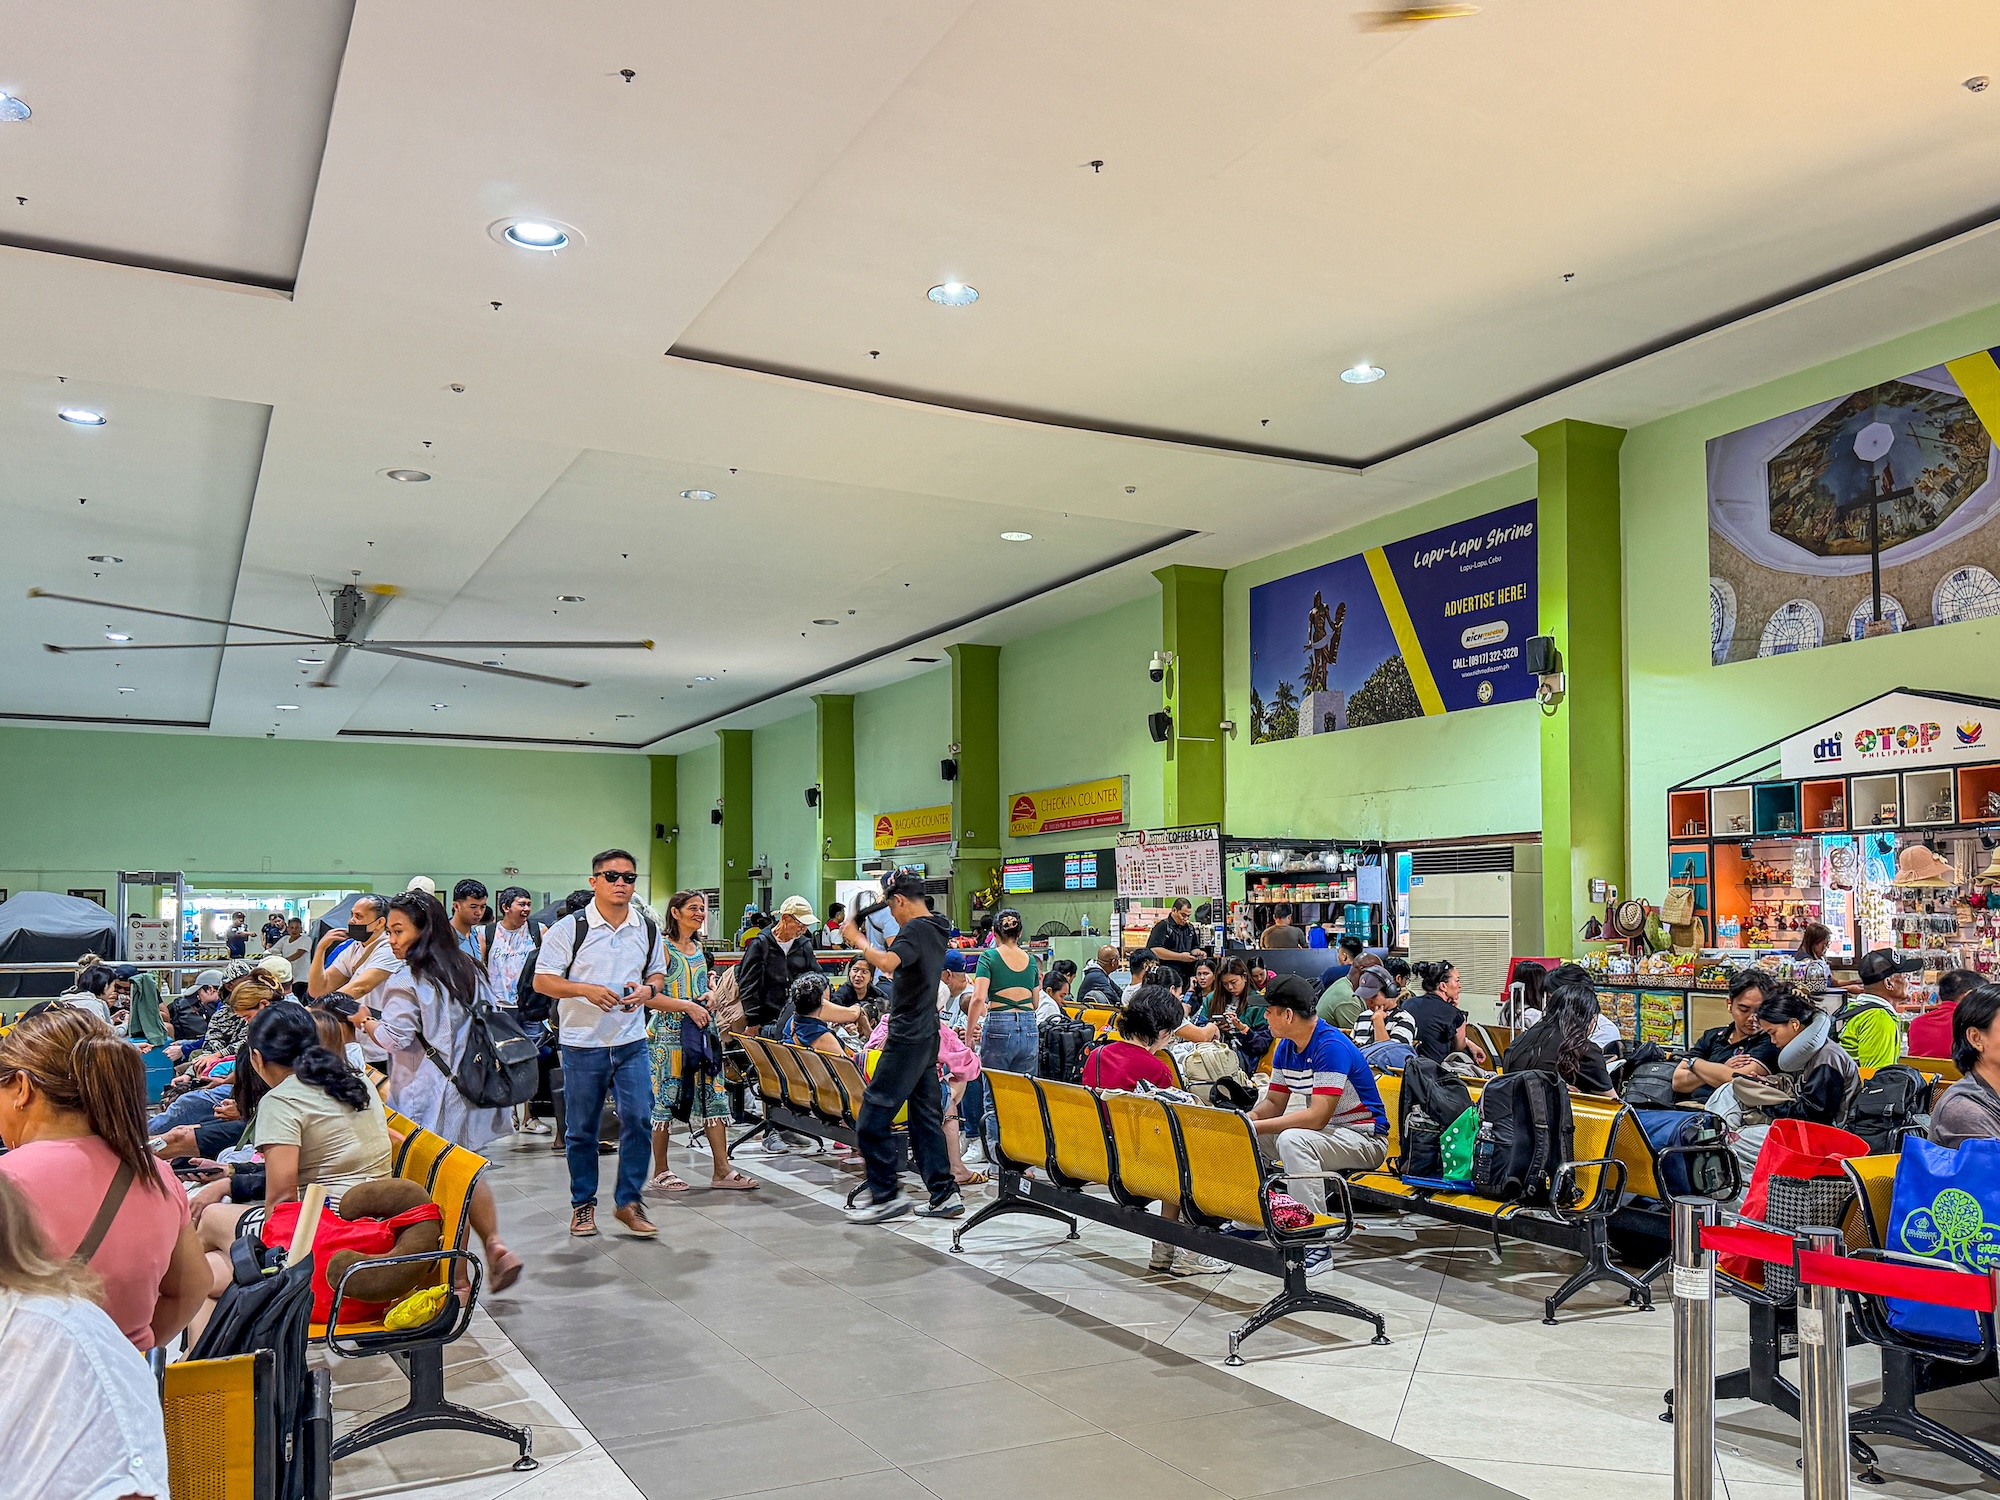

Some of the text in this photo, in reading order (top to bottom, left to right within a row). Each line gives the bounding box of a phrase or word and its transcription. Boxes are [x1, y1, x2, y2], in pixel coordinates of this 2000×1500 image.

[1413, 522, 1533, 568] Lapu-Lapu Shrine
[1488, 555, 1502, 566] Cebu
[1444, 582, 1527, 617] ADVERTISE HERE!
[1452, 646, 1519, 669] CALL: (0917) 322-3220
[1814, 722, 1941, 758] dti OTOP
[1862, 746, 1933, 759] PHILIPPINES
[1041, 787, 1118, 812] CHECK-IN COUNTER
[895, 813, 949, 831] BAGGAGE COUNTER
[1011, 821, 1036, 833] OCEANJET
[1169, 832, 1192, 843] COFFEE
[1200, 828, 1213, 840] TEA
[1976, 1231, 1993, 1242] GO
